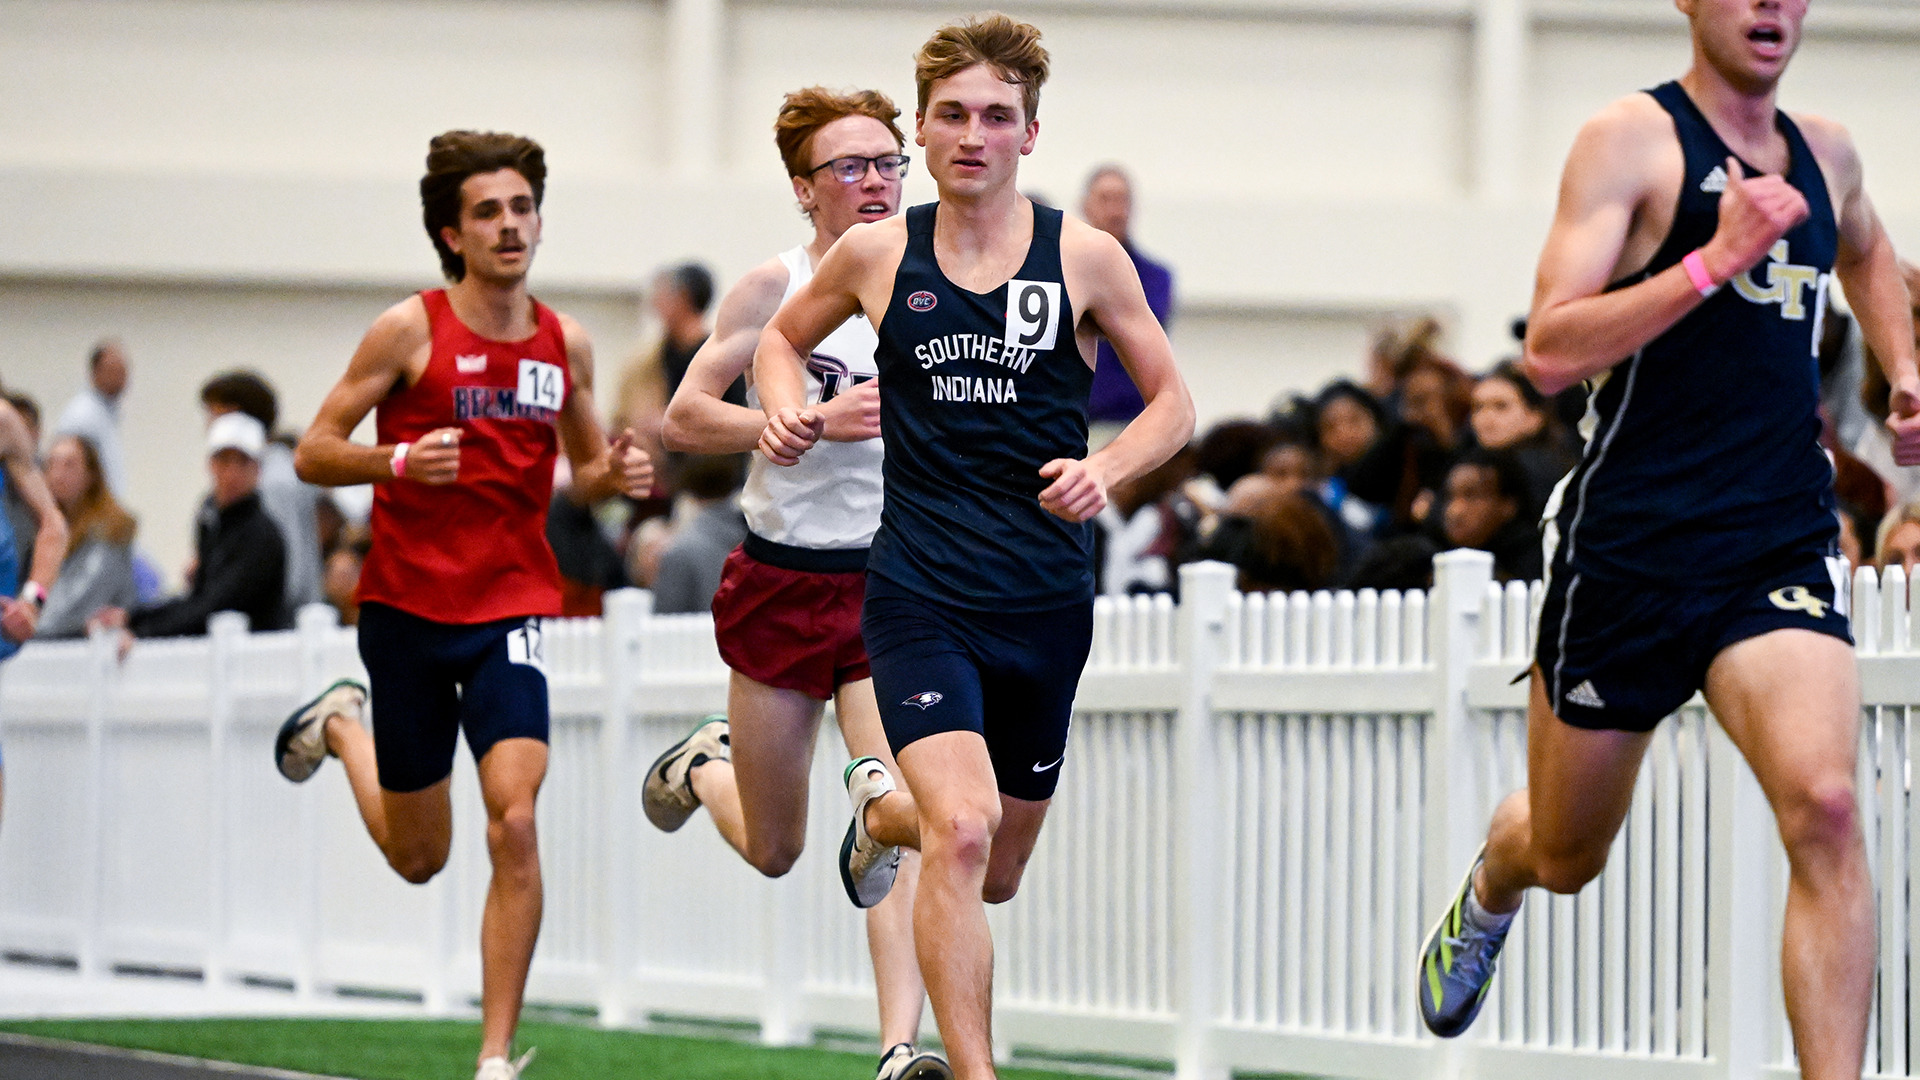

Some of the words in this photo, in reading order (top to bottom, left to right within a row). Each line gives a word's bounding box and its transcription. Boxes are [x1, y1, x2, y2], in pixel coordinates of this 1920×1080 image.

[1018, 284, 1049, 346] 9
[914, 333, 1037, 375] SOUTHERN
[528, 366, 556, 404] 14
[932, 375, 1018, 404] INDIANA
